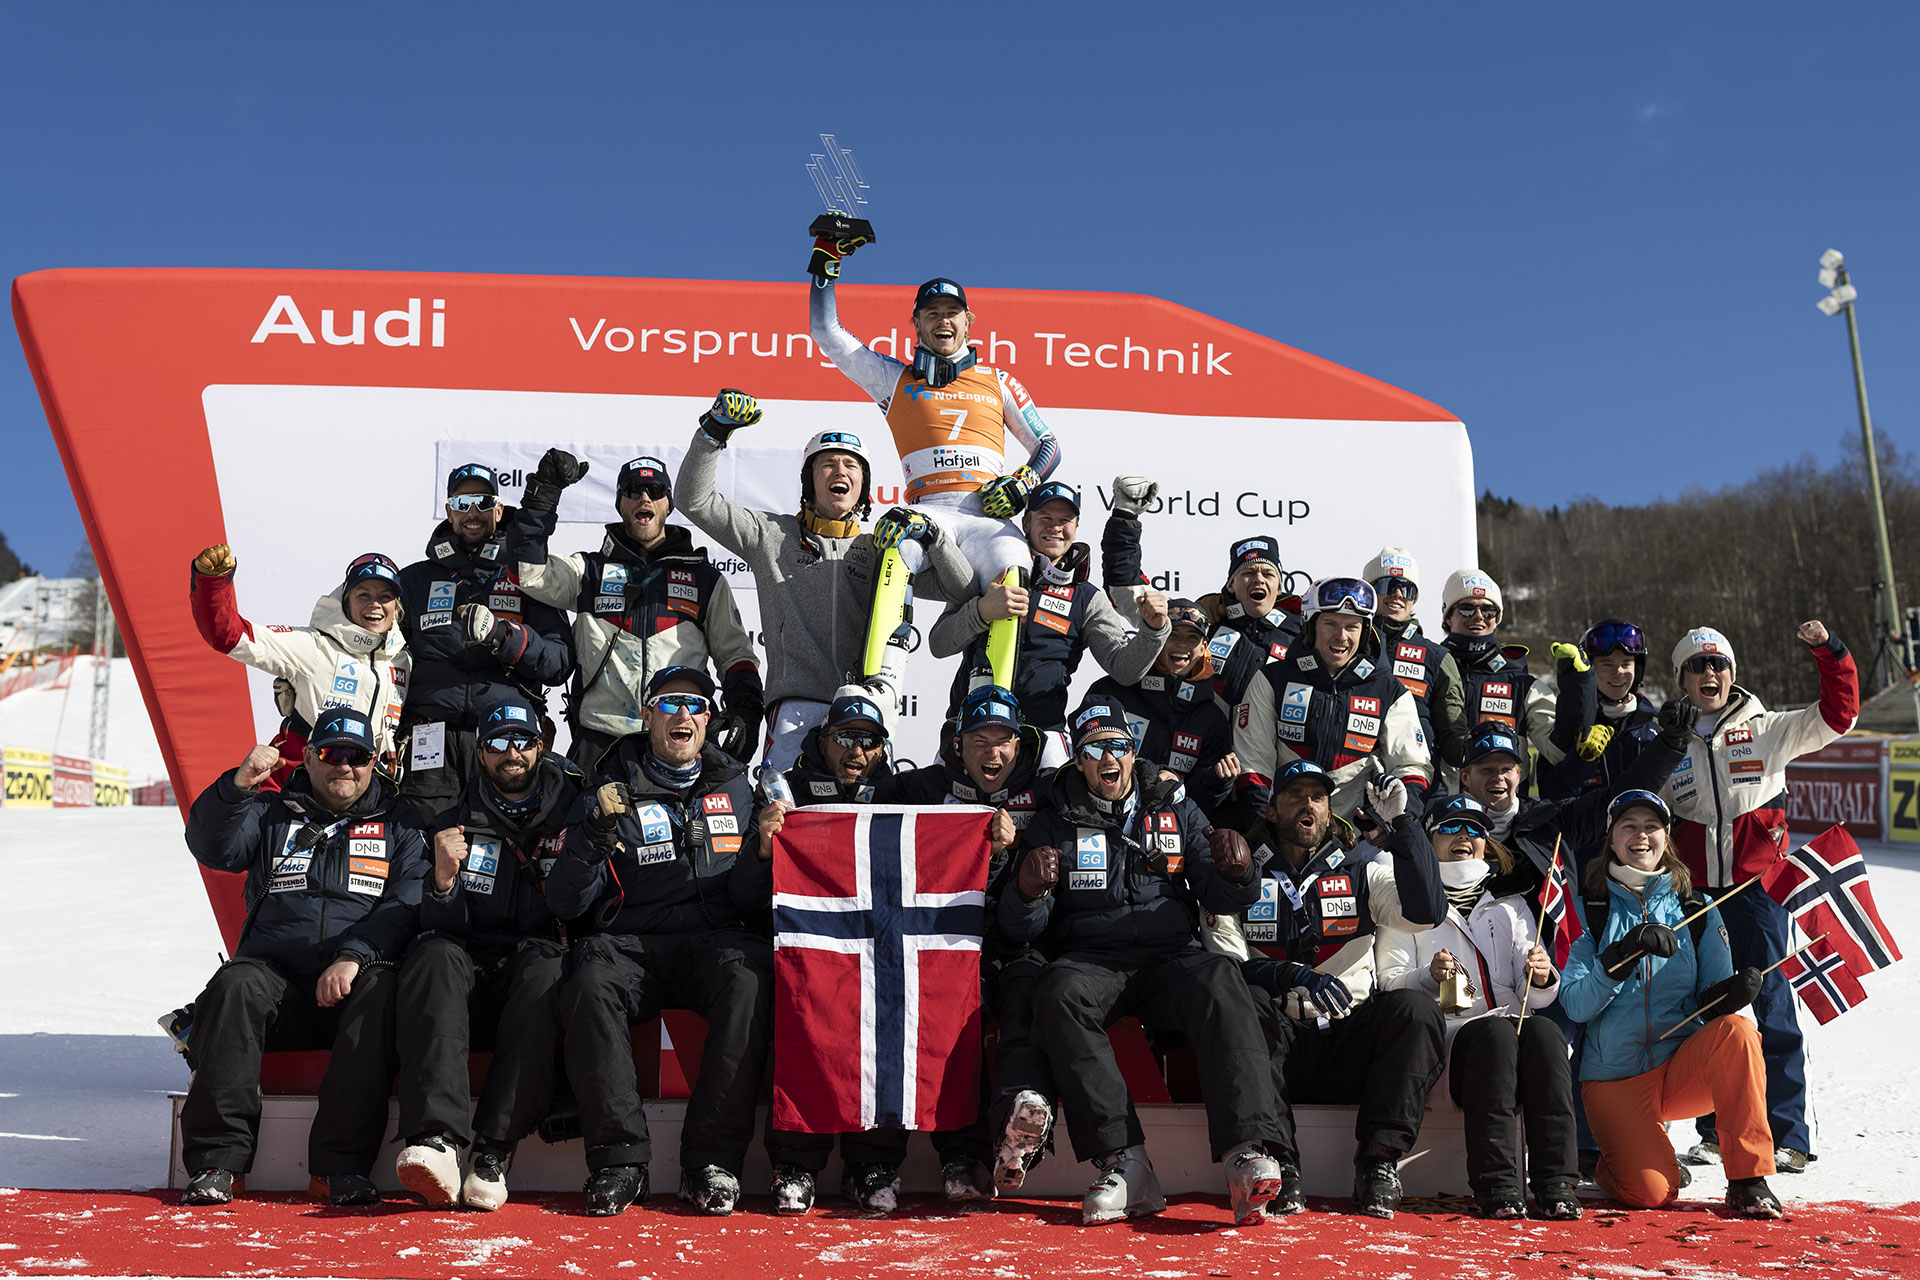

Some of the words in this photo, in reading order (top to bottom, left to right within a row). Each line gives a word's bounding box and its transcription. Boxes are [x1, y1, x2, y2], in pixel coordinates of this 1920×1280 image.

[251, 295, 446, 347] Audi
[1034, 333, 1233, 376] Technik
[934, 391, 998, 406] NorEngros
[939, 409, 968, 441] 7
[1026, 409, 1043, 432] DNB
[934, 454, 980, 469] Hafjell
[1235, 492, 1310, 525] Cup
[671, 570, 692, 582] HH
[884, 558, 893, 586] LEKI
[494, 582, 516, 591] HH
[605, 583, 623, 592] 5G
[672, 585, 694, 597] DNB
[431, 599, 449, 608] 5G
[494, 597, 516, 610] DNB
[595, 602, 623, 610] KPMG
[1044, 600, 1066, 613] DNB
[422, 617, 448, 629] KPMG
[353, 634, 373, 646] DNB
[1210, 644, 1227, 654] 5G
[1400, 646, 1422, 659] HH
[1469, 642, 1486, 651] HH
[1398, 664, 1420, 676] DNB
[336, 680, 355, 691] 5G
[1144, 678, 1160, 688] DNB
[1486, 684, 1508, 695] HH
[1354, 699, 1376, 711] HH
[1486, 700, 1507, 711] DNB
[1285, 707, 1303, 718] 5G
[1353, 718, 1375, 731] DNB
[1279, 729, 1302, 740] KPMG
[1728, 731, 1749, 742] HH
[1177, 735, 1198, 750] HH
[1731, 746, 1752, 758] DNB
[1174, 756, 1192, 772] DNB
[813, 783, 833, 795] DNB
[1672, 777, 1694, 791] KPMG
[956, 786, 972, 798] DNB
[705, 797, 729, 809] HH
[1008, 793, 1032, 805] HH
[1785, 780, 1877, 824] GENERALI
[354, 825, 379, 835] HH
[713, 817, 735, 831] DNB
[648, 826, 667, 838] 5G
[355, 840, 380, 854] DNB
[640, 852, 672, 863] KPMG
[1082, 854, 1101, 865] 5G
[473, 858, 493, 870] 5G
[1071, 879, 1104, 889] KPMG
[1322, 879, 1347, 893] HH
[1252, 904, 1273, 916] 5G
[1327, 899, 1352, 915] DNB
[1245, 930, 1274, 940] KPMG
